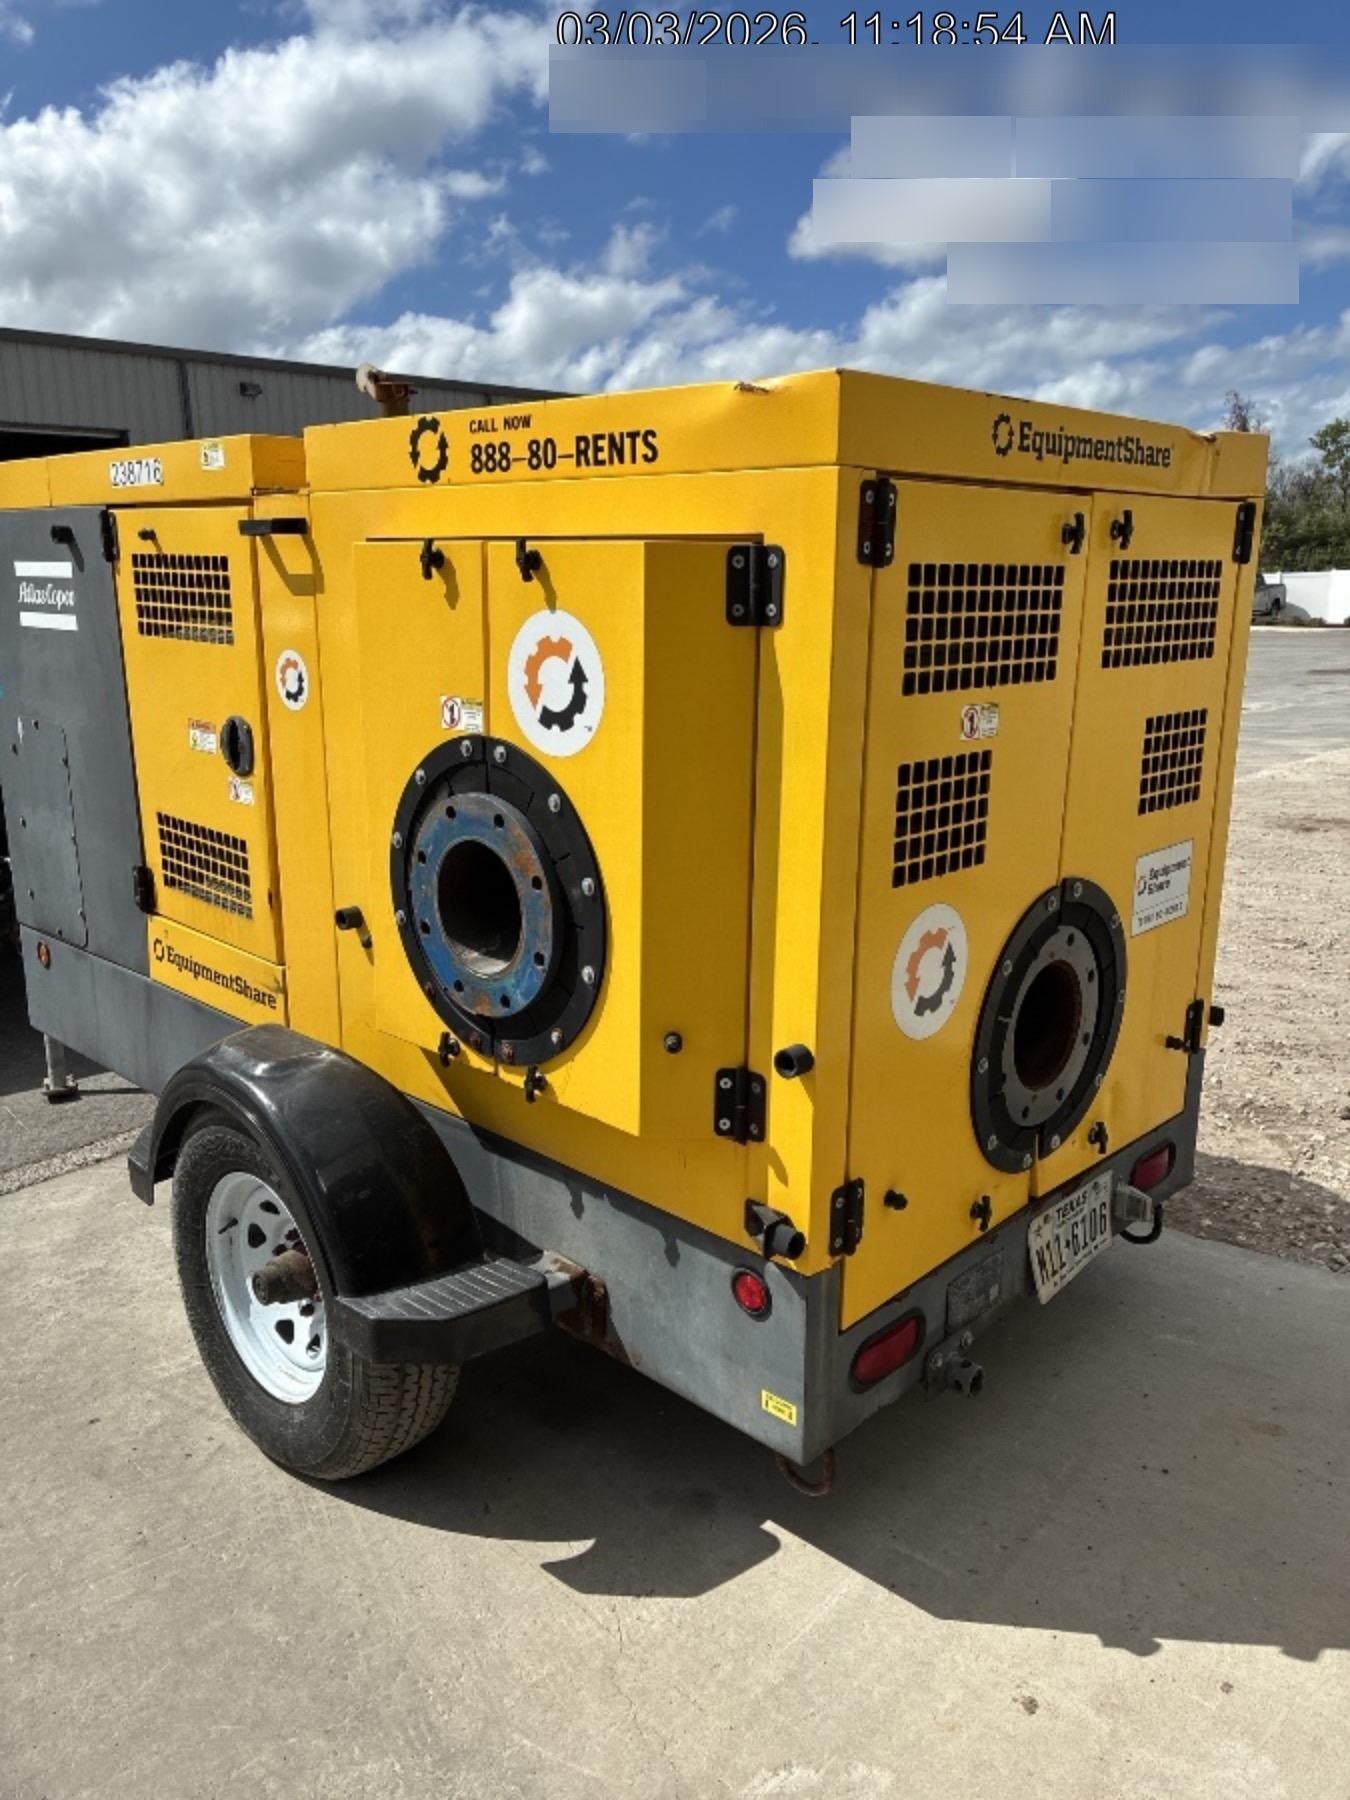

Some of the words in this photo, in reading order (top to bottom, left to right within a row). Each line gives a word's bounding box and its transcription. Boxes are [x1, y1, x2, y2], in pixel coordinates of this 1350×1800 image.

[469, 418, 498, 433] CALL
[503, 414, 532, 430] NOW
[471, 429, 658, 474] 888-80-RENTS
[1017, 420, 1172, 468] EquipmentShare
[111, 460, 163, 486] 238716
[166, 944, 277, 1009] EquipmentShare
[1055, 1190, 1088, 1219] TEXAS
